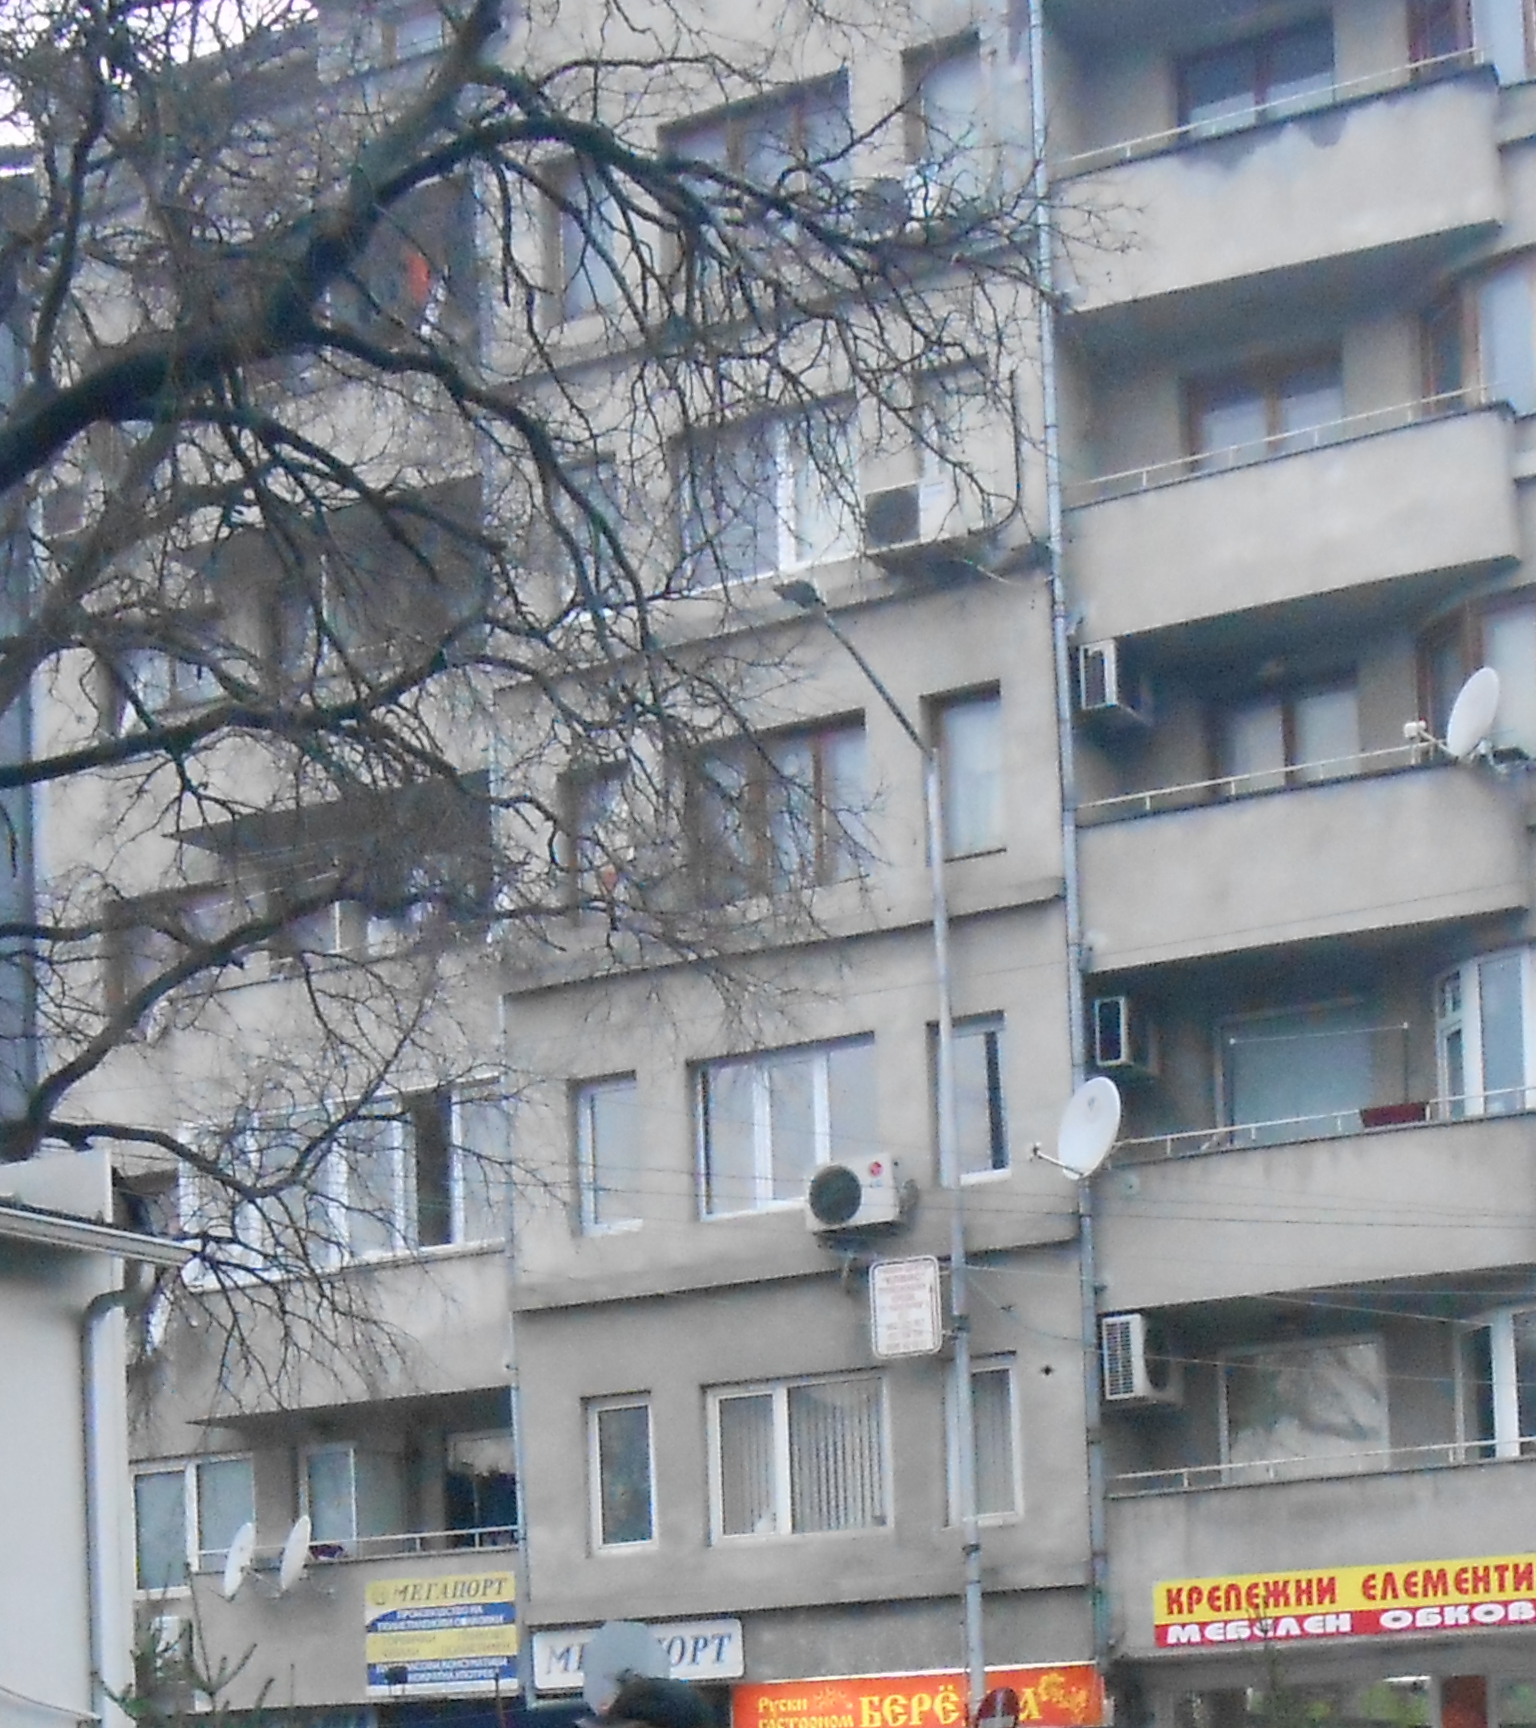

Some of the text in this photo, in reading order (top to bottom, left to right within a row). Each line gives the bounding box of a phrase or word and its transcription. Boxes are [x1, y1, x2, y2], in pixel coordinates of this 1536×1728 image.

[393, 1577, 508, 1602] МЕГАПОРТ
[1165, 1561, 1535, 1616] КРЕПЕЖНИ ЕЛЕМЕНТИ
[1166, 1600, 1536, 1645] МЕБЕЛЕН ОБКОВ
[546, 1633, 732, 1675] МОРТ
[757, 1695, 808, 1714] Руски
[859, 1684, 1042, 1728] БЕРЁА
